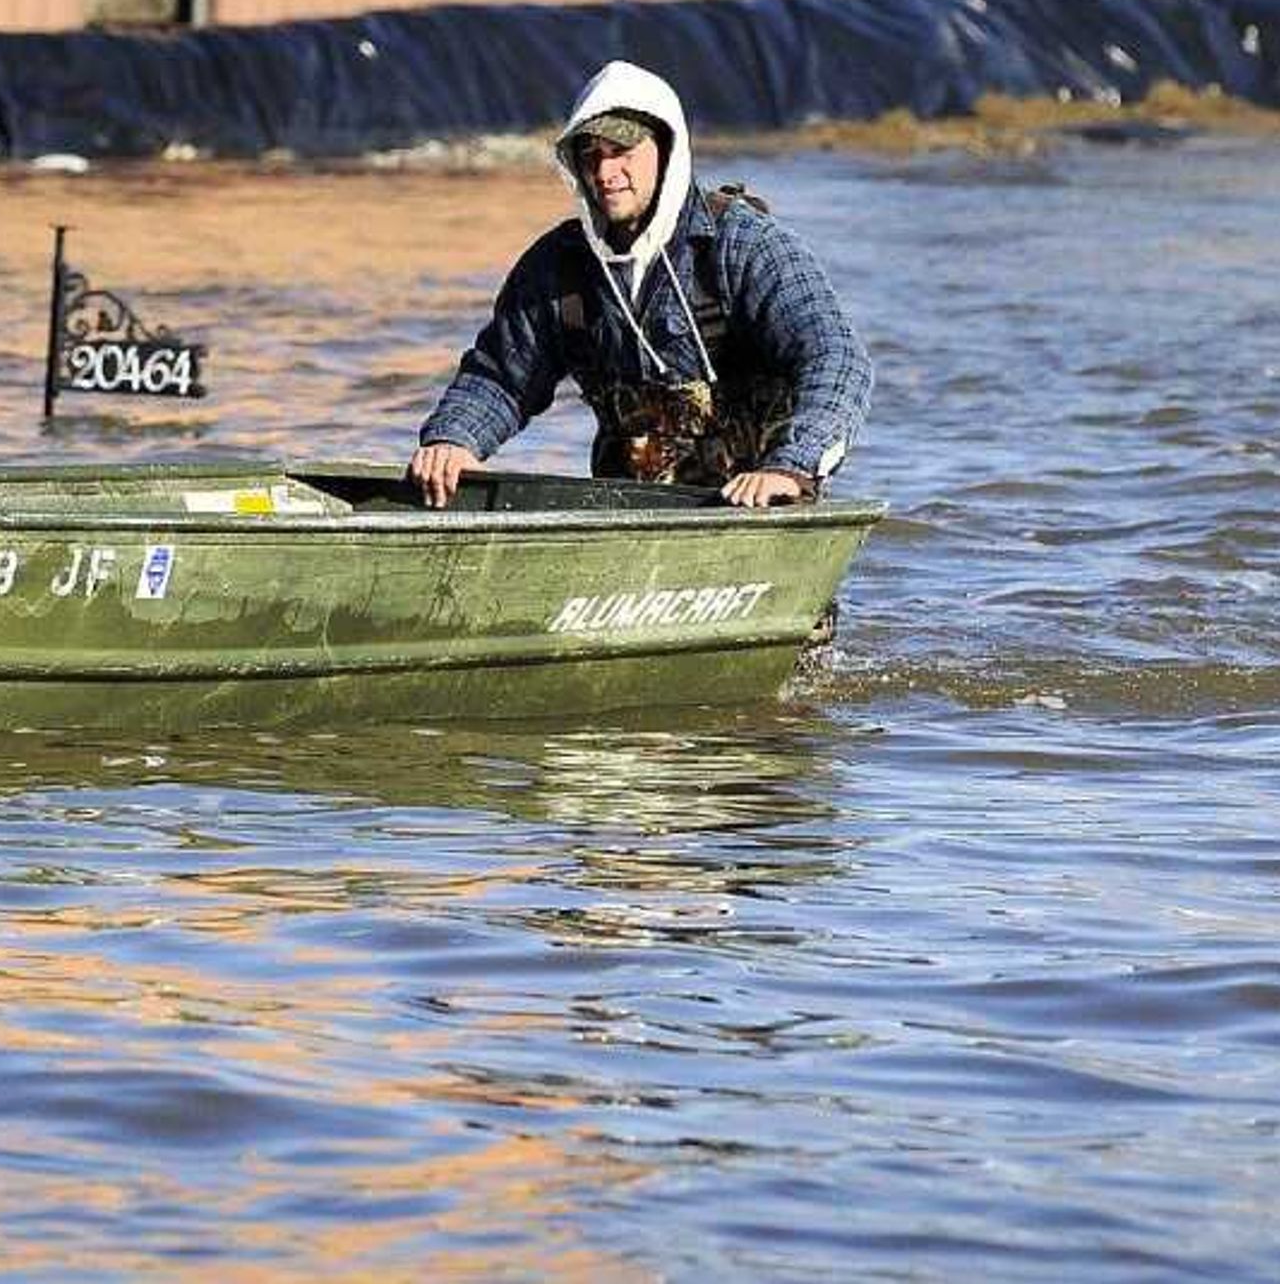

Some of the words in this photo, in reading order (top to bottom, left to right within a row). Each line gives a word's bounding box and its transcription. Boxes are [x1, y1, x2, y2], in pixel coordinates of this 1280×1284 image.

[71, 344, 191, 394] 20464
[51, 548, 116, 597] JF
[546, 580, 774, 633] ALUMACRAFT
